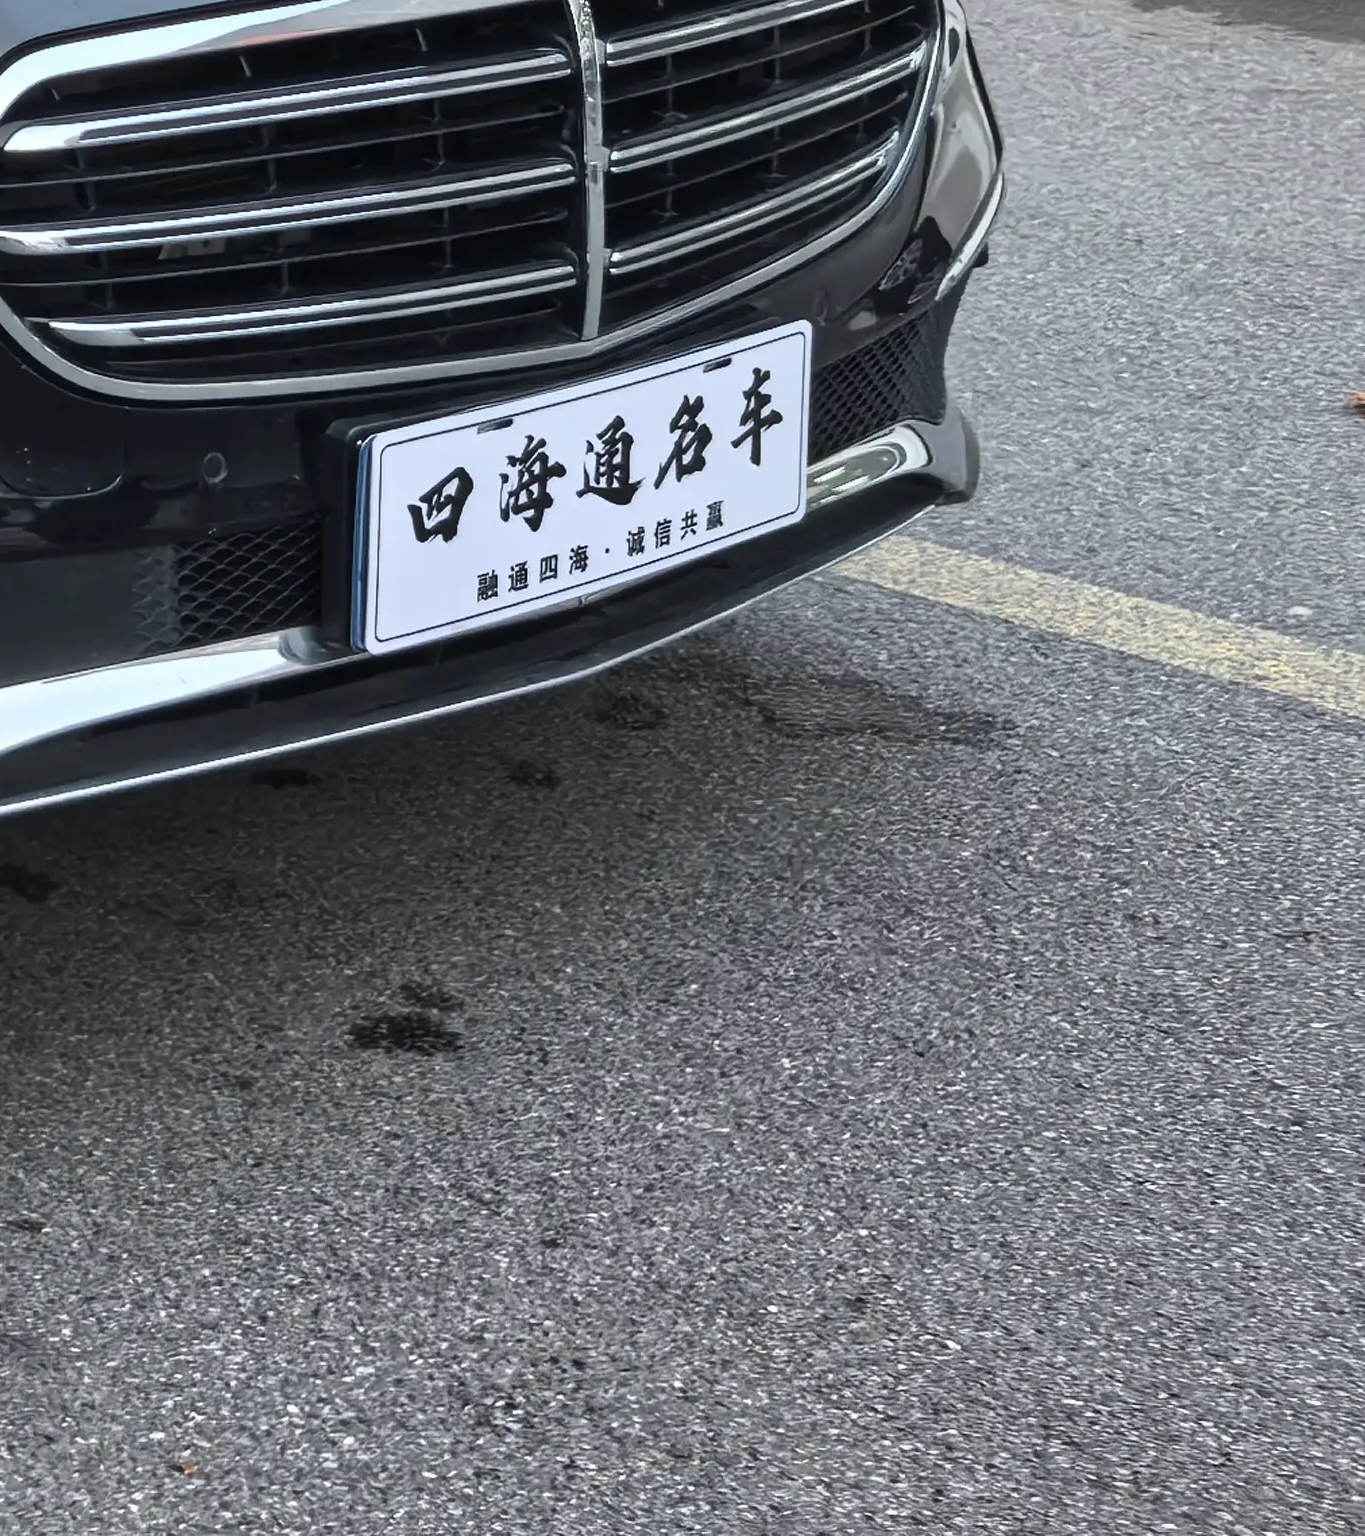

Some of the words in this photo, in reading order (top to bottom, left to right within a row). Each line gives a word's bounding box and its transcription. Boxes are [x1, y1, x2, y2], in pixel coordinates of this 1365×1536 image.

[407, 368, 784, 542] 四海通名车
